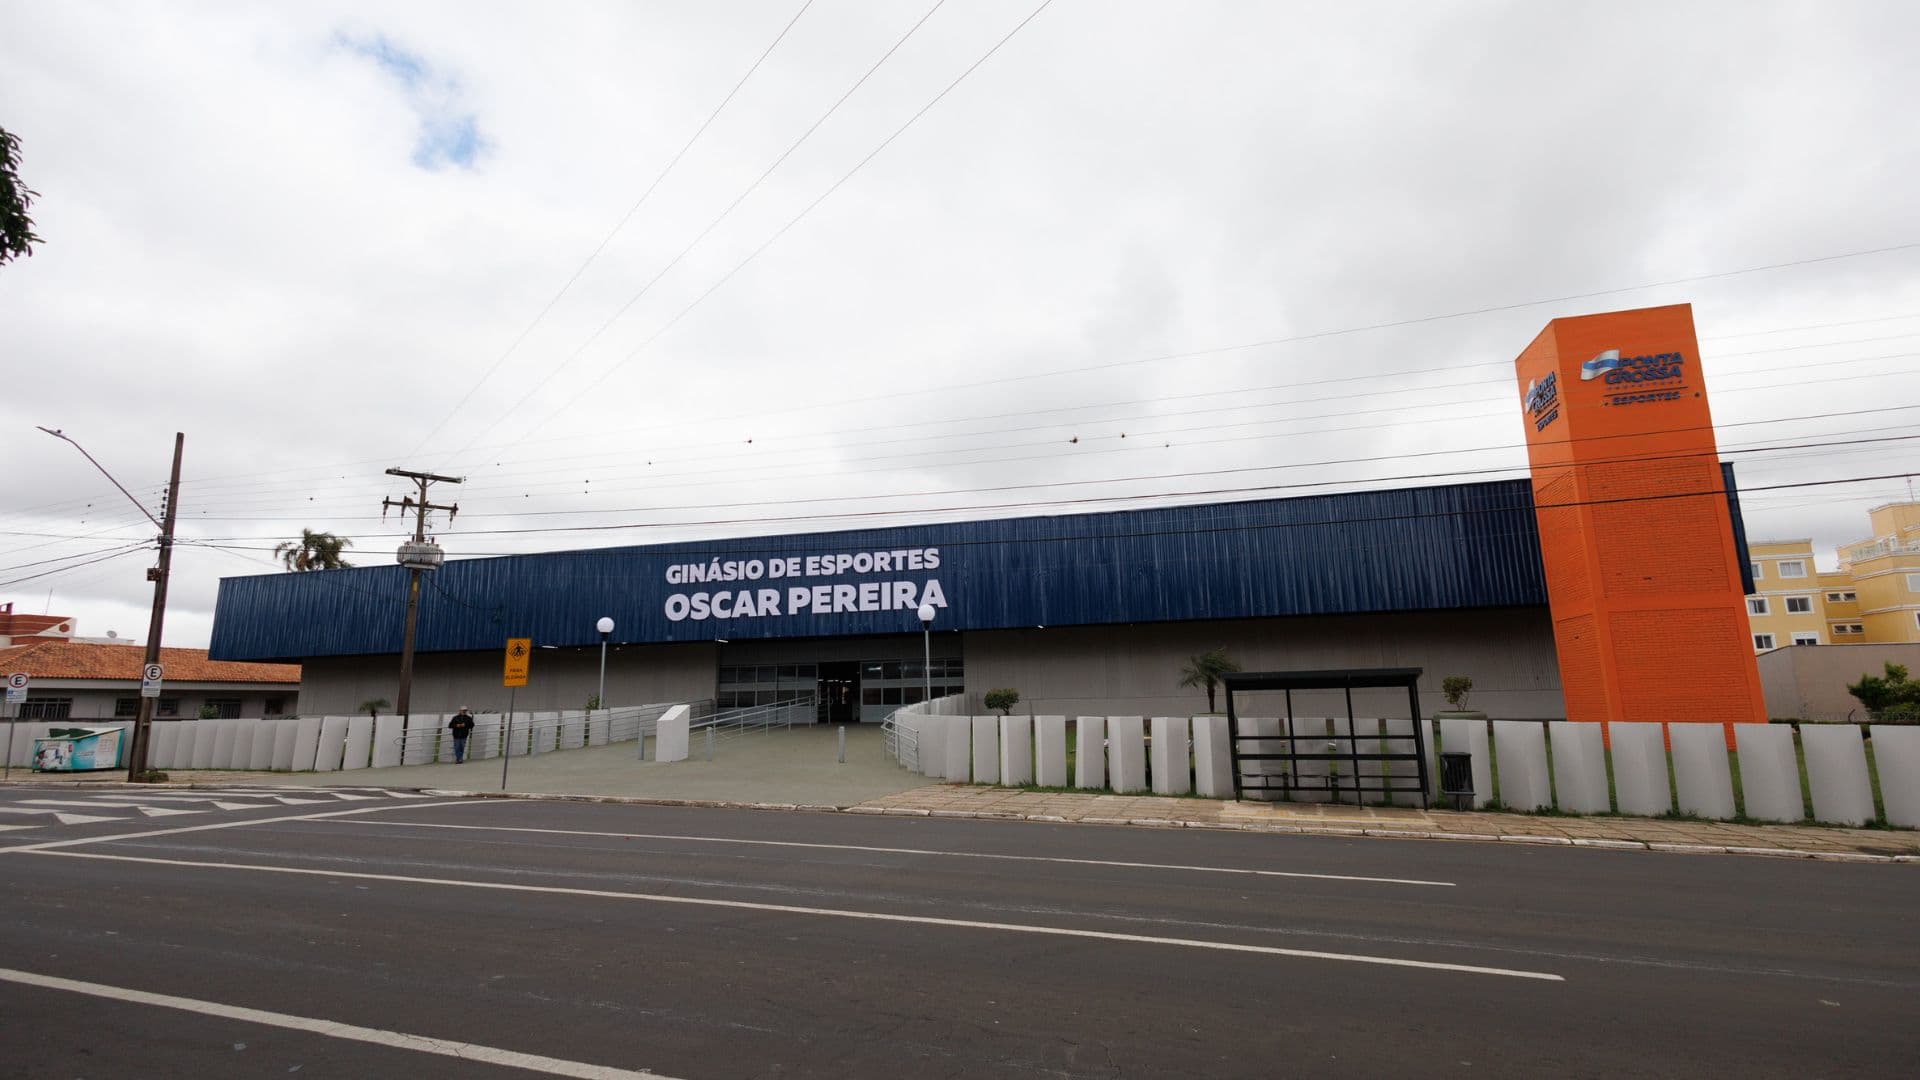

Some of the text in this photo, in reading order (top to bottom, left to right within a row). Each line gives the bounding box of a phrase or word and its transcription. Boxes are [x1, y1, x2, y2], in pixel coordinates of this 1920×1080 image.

[1619, 352, 1684, 367] PONTA
[1605, 366, 1681, 384] GROSSA
[1612, 391, 1680, 405] ESPORTES
[665, 548, 940, 584] GINÁSIO DE ESPORTES
[665, 580, 948, 621] OSCAR PEREIRA
[150, 668, 157, 677] E
[15, 676, 22, 685] E
